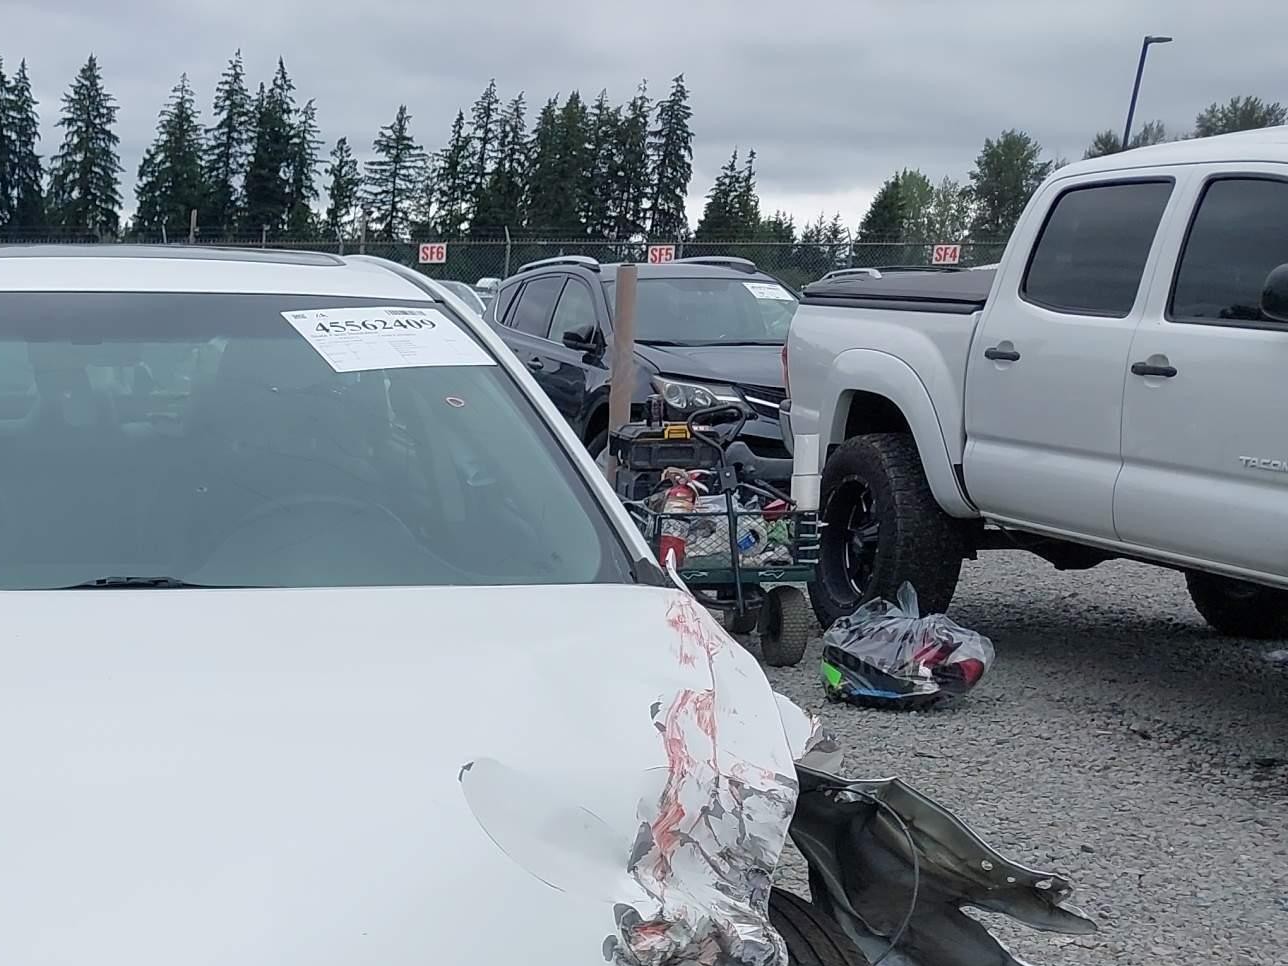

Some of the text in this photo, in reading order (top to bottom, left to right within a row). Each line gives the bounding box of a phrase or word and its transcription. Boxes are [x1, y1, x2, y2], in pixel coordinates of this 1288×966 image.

[421, 245, 445, 261] SF6
[650, 247, 673, 264] SF5
[935, 246, 958, 262] SF4
[315, 318, 436, 333] 45562409
